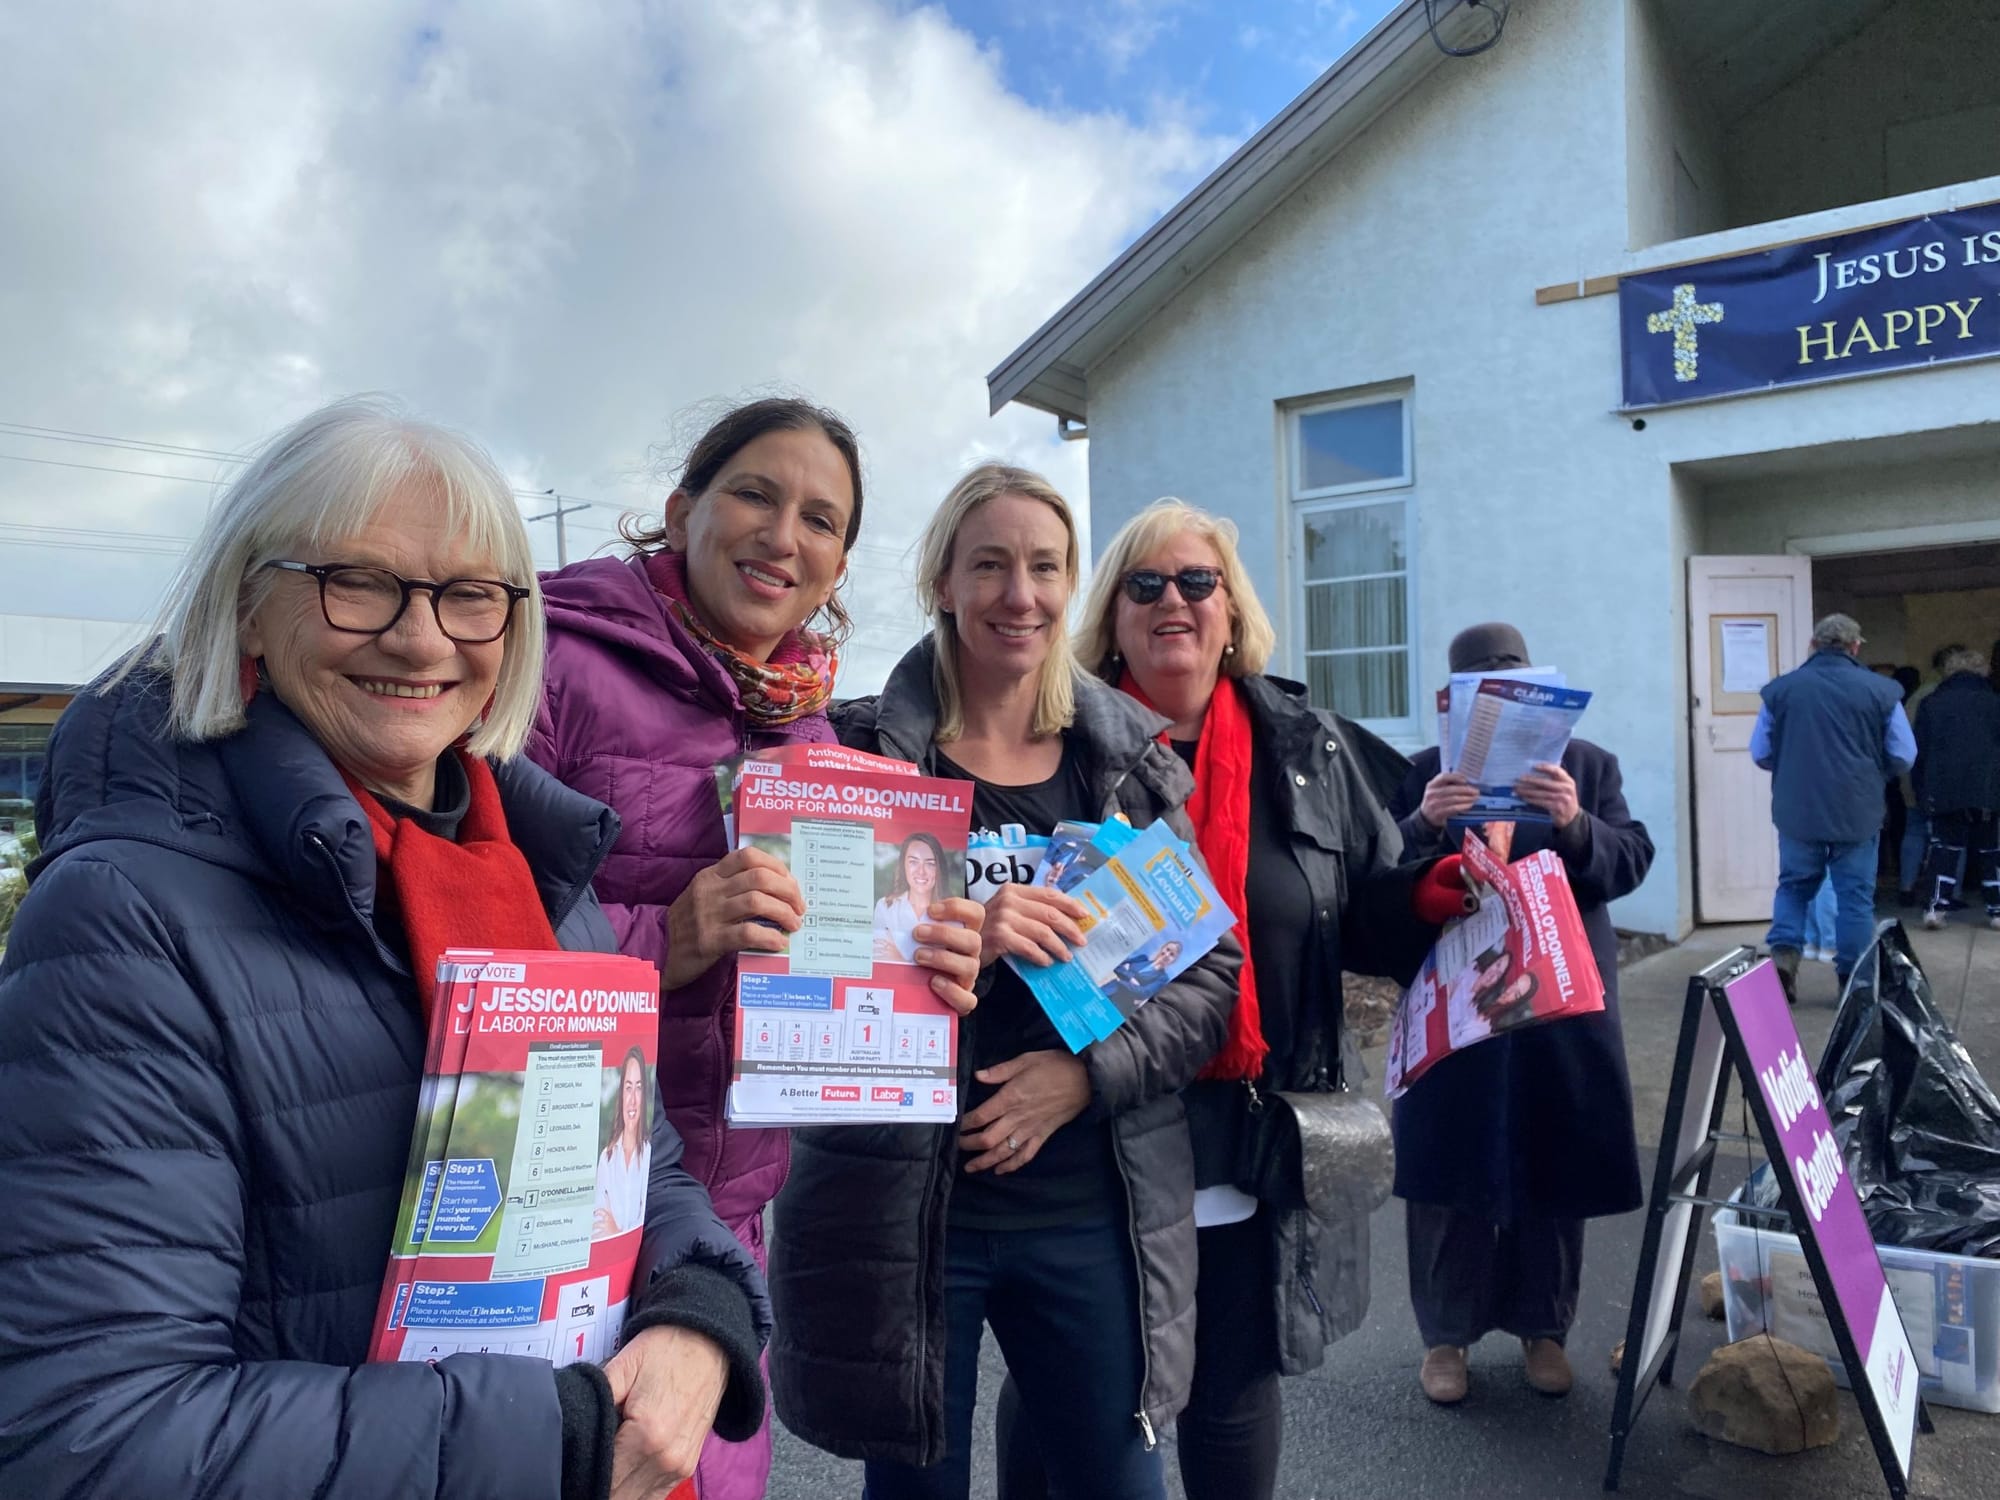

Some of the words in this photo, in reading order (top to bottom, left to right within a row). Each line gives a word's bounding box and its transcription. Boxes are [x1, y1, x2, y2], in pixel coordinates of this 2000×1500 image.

[1812, 241, 1946, 304] JESUS
[1962, 231, 2000, 266] IS
[1796, 297, 1982, 365] HAPPY
[807, 748, 850, 761] Anthony
[852, 754, 894, 772] Albanese
[749, 766, 774, 775] VOTE
[746, 778, 839, 801] JESSICA
[842, 786, 965, 813] O'DONNELL
[746, 799, 794, 810] LABOR
[798, 802, 825, 813] FOR
[828, 803, 892, 819] MONASH
[968, 826, 999, 846] ote
[1162, 860, 1184, 888] Deb
[1152, 867, 1195, 922] Leonard
[1527, 859, 1550, 915] JESSICA
[1542, 916, 1575, 1002] O'DONNELL
[486, 967, 517, 978] VOTE
[743, 975, 761, 984] Step
[481, 987, 578, 1012] JESSICA
[580, 990, 657, 1013] O'DONNELL
[866, 992, 873, 1000] K
[479, 1016, 535, 1033] LABOR
[538, 1016, 566, 1032] FOR
[567, 1016, 618, 1032] MONASH
[761, 1032, 768, 1041] 6
[793, 1033, 800, 1043] 3
[823, 1035, 831, 1044] 5
[864, 1025, 871, 1042] 1
[902, 1038, 908, 1047] 2
[928, 1040, 935, 1048] 4
[1762, 1042, 1819, 1132] Voting
[790, 1089, 819, 1097] Better
[825, 1089, 858, 1098] Future.
[874, 1089, 900, 1099] Labor
[449, 1164, 475, 1175] Step
[477, 1164, 485, 1173] 1.
[1796, 1129, 1843, 1222] Centre
[541, 1188, 575, 1197] O'DONNELL,
[441, 1197, 461, 1205] Start
[439, 1206, 454, 1214] and
[454, 1207, 470, 1215] you
[434, 1224, 459, 1233] every
[416, 1285, 445, 1297] Step
[446, 1285, 458, 1295] 2.
[581, 1286, 589, 1298] K
[410, 1306, 432, 1315] Place
[439, 1307, 471, 1315] number
[490, 1307, 505, 1315] box
[505, 1306, 515, 1314] K.
[517, 1305, 534, 1313] Then
[407, 1315, 440, 1323] number
[454, 1317, 477, 1325] boxes
[488, 1316, 513, 1324] shown
[575, 1333, 585, 1357] 1
